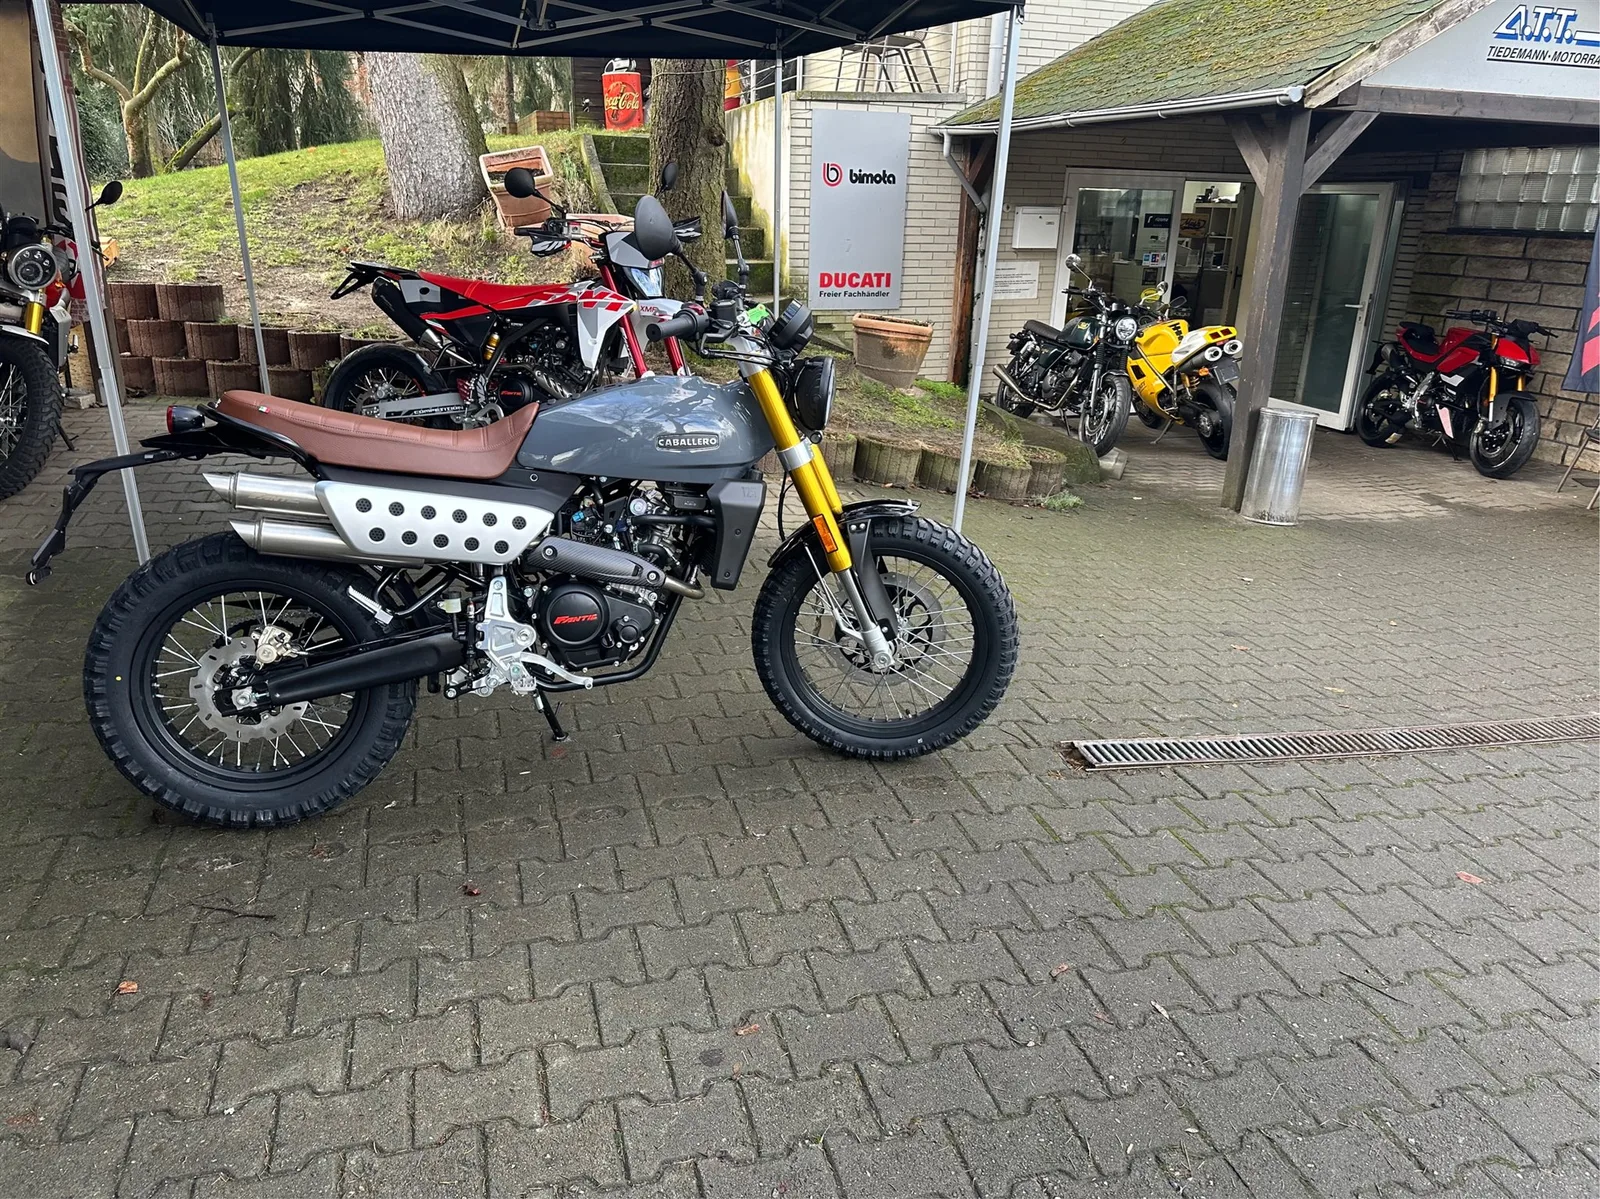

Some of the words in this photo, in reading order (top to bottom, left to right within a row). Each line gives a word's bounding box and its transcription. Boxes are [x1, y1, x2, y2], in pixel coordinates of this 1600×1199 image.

[1493, 4, 1578, 44] A.T.T.
[849, 169, 896, 184] bimota
[819, 272, 892, 288] DUCATI
[413, 406, 464, 415] COMPETITION
[658, 437, 717, 447] CABALLERO
[553, 613, 598, 625] FANTIC
